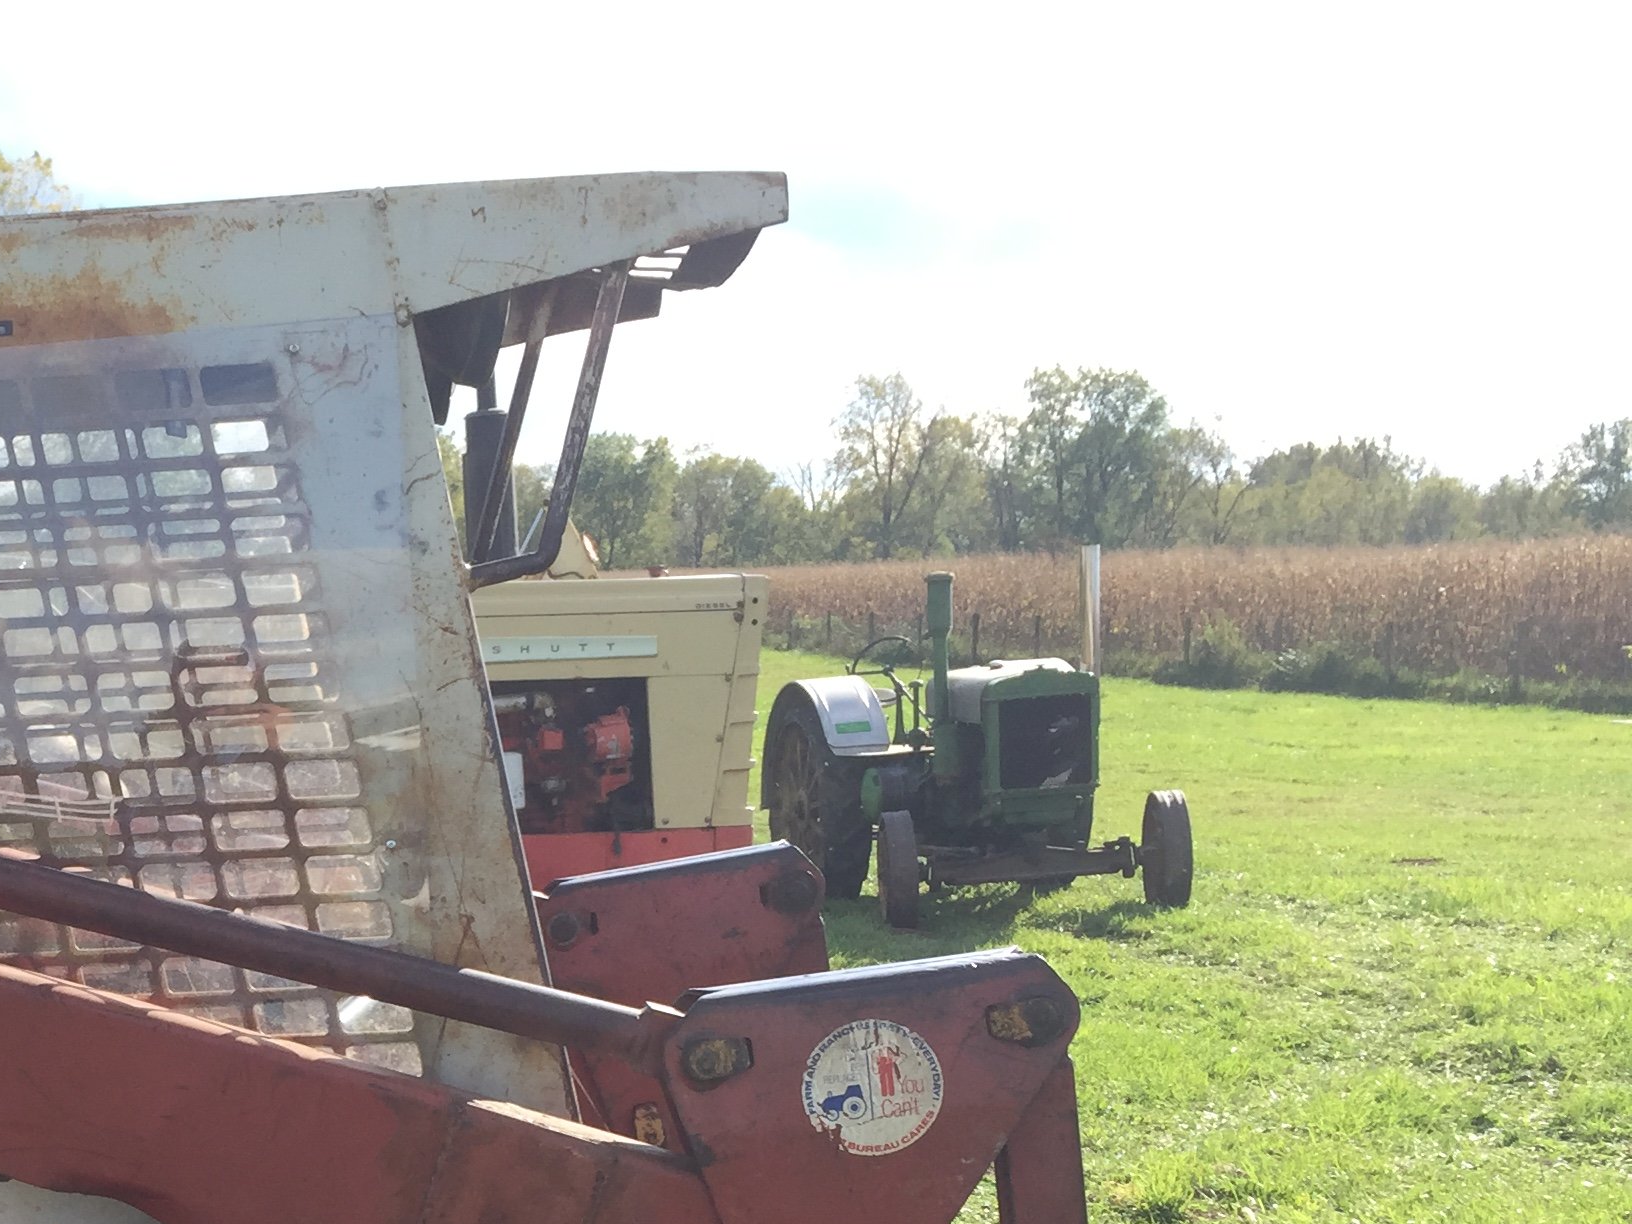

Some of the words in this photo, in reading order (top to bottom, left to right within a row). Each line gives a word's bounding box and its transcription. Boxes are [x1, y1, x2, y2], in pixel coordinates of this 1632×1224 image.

[807, 1053, 821, 1079] AND
[804, 1080, 816, 1115] FARM
[898, 1075, 925, 1094] You
[847, 1140, 900, 1153] BUREAU
[900, 1110, 935, 1144] CARES
